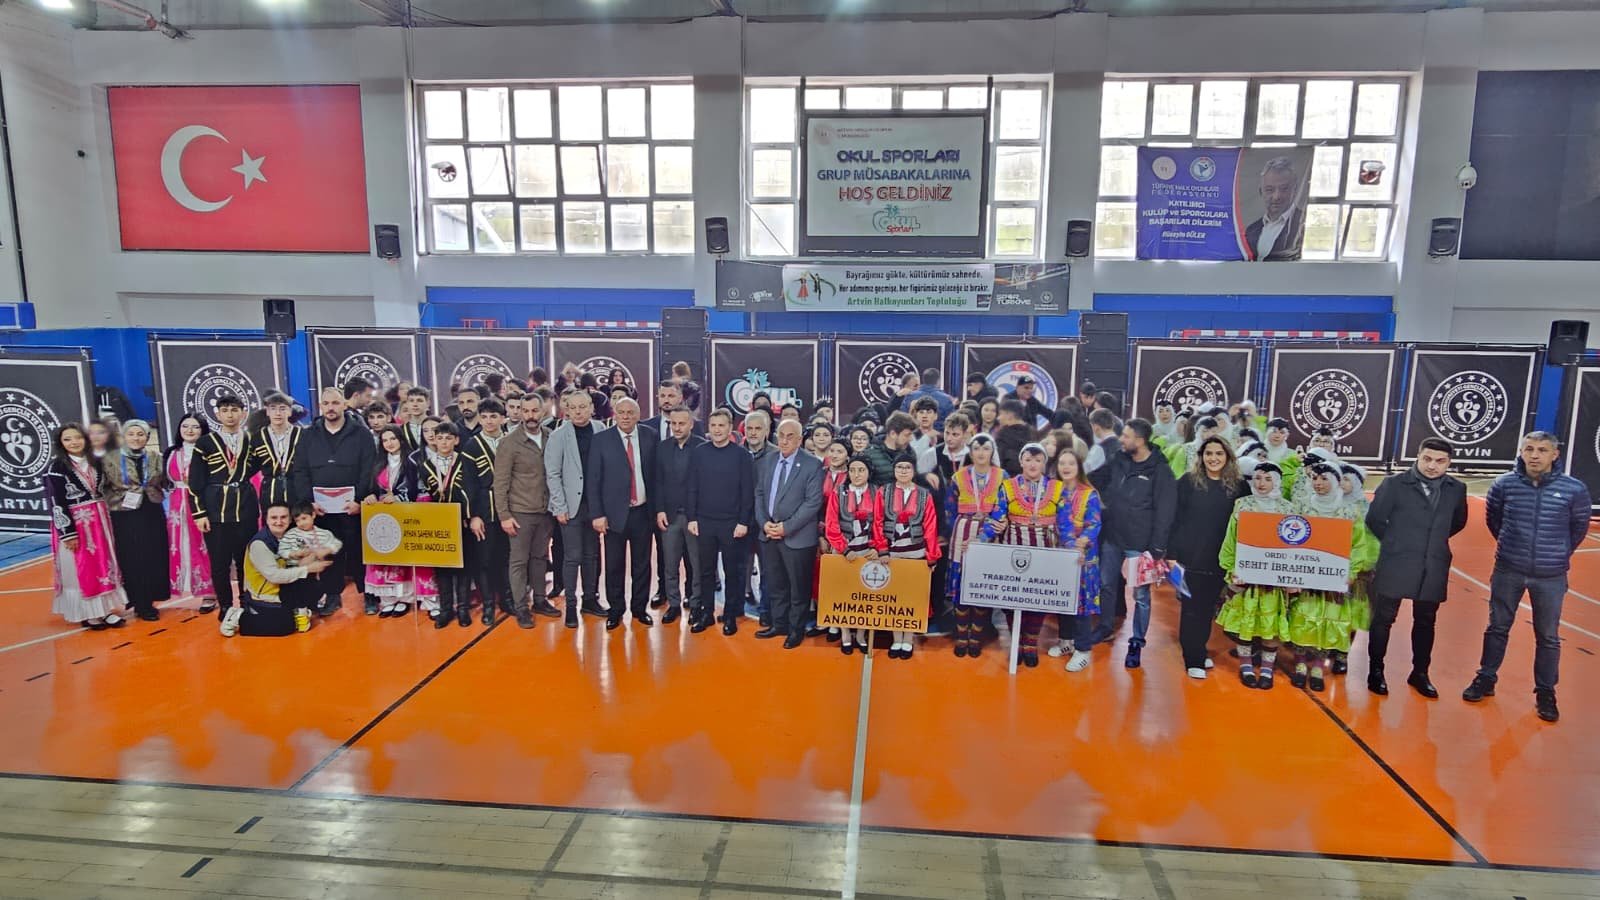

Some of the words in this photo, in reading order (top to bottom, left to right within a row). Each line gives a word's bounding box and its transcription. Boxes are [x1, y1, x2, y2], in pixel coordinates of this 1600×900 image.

[837, 150, 880, 163] OKUL
[882, 150, 960, 163] SPORLARI
[817, 169, 850, 181] GRUP
[853, 167, 971, 181] MÜSABAKALARINA
[839, 186, 873, 204] HOŞ
[876, 183, 953, 201] GELDİNİZ
[1151, 190, 1220, 198] FEDERASYONU
[1168, 200, 1206, 208] KATILIMCI
[1143, 208, 1169, 217] KULÜP
[1180, 209, 1229, 219] SPORCULARA
[1149, 218, 1191, 226] BAŞARILAR
[1191, 218, 1222, 227] DİLERİM
[847, 297, 872, 305] Artvin
[0, 498, 49, 511] RTVİ
[1264, 551, 1288, 559] ORDU
[1294, 554, 1321, 562] FATSA
[983, 573, 1021, 582] TRABZON
[1028, 577, 1059, 586] ARAKLI
[1277, 575, 1305, 585] MTAL
[969, 582, 998, 591] SAFFET
[851, 592, 897, 603] GİRESUN
[1002, 595, 1040, 605] ANADOLU
[833, 602, 873, 614] MİMAR
[876, 605, 914, 617] SİNAN
[823, 614, 881, 627] ANADOLU
[885, 618, 922, 630] LİSESİ
